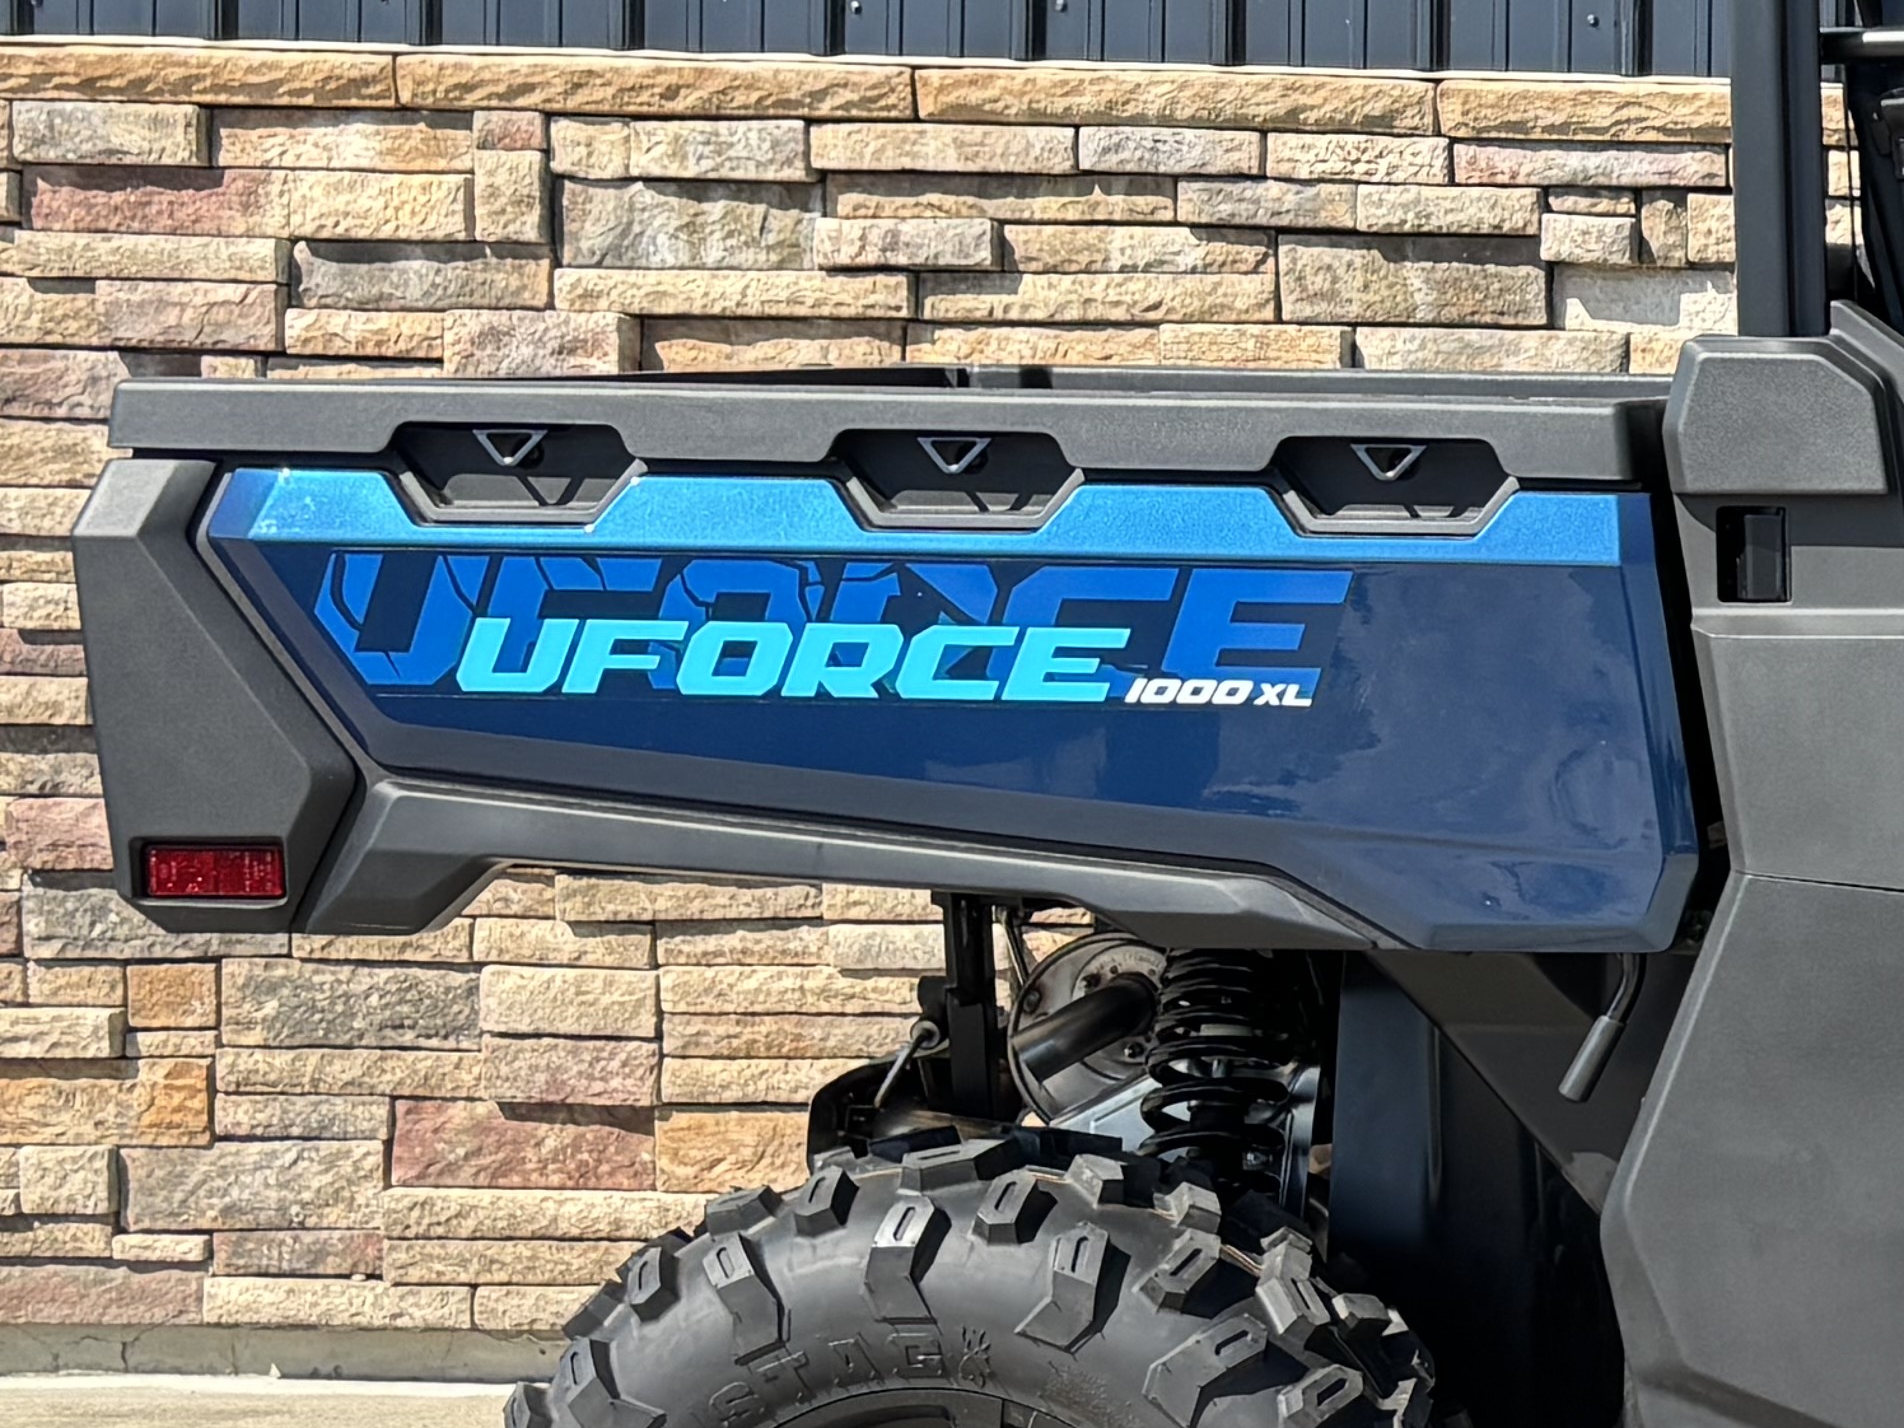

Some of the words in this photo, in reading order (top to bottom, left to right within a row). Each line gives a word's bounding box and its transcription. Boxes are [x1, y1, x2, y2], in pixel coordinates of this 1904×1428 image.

[455, 617, 1131, 702] UFORCE
[1123, 678, 1255, 705] 1000
[1253, 683, 1313, 707] XL
